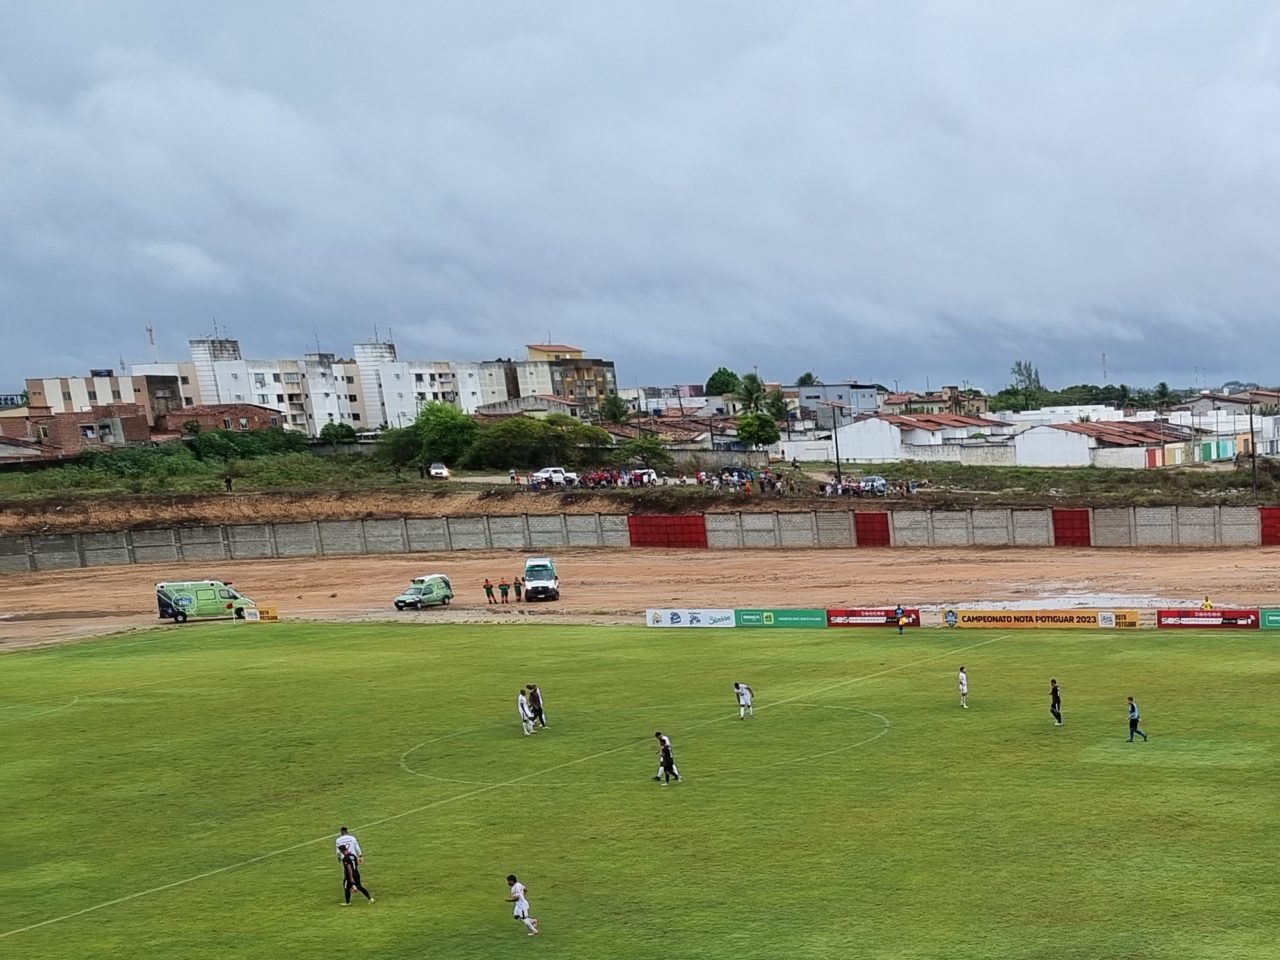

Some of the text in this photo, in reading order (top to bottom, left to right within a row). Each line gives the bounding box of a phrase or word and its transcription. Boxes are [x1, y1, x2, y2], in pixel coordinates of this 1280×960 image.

[961, 615, 1013, 623] CAMPEONATO
[1013, 615, 1034, 623] NOTA
[1035, 615, 1075, 623] POTIGUAR
[1076, 615, 1097, 623] 2023
